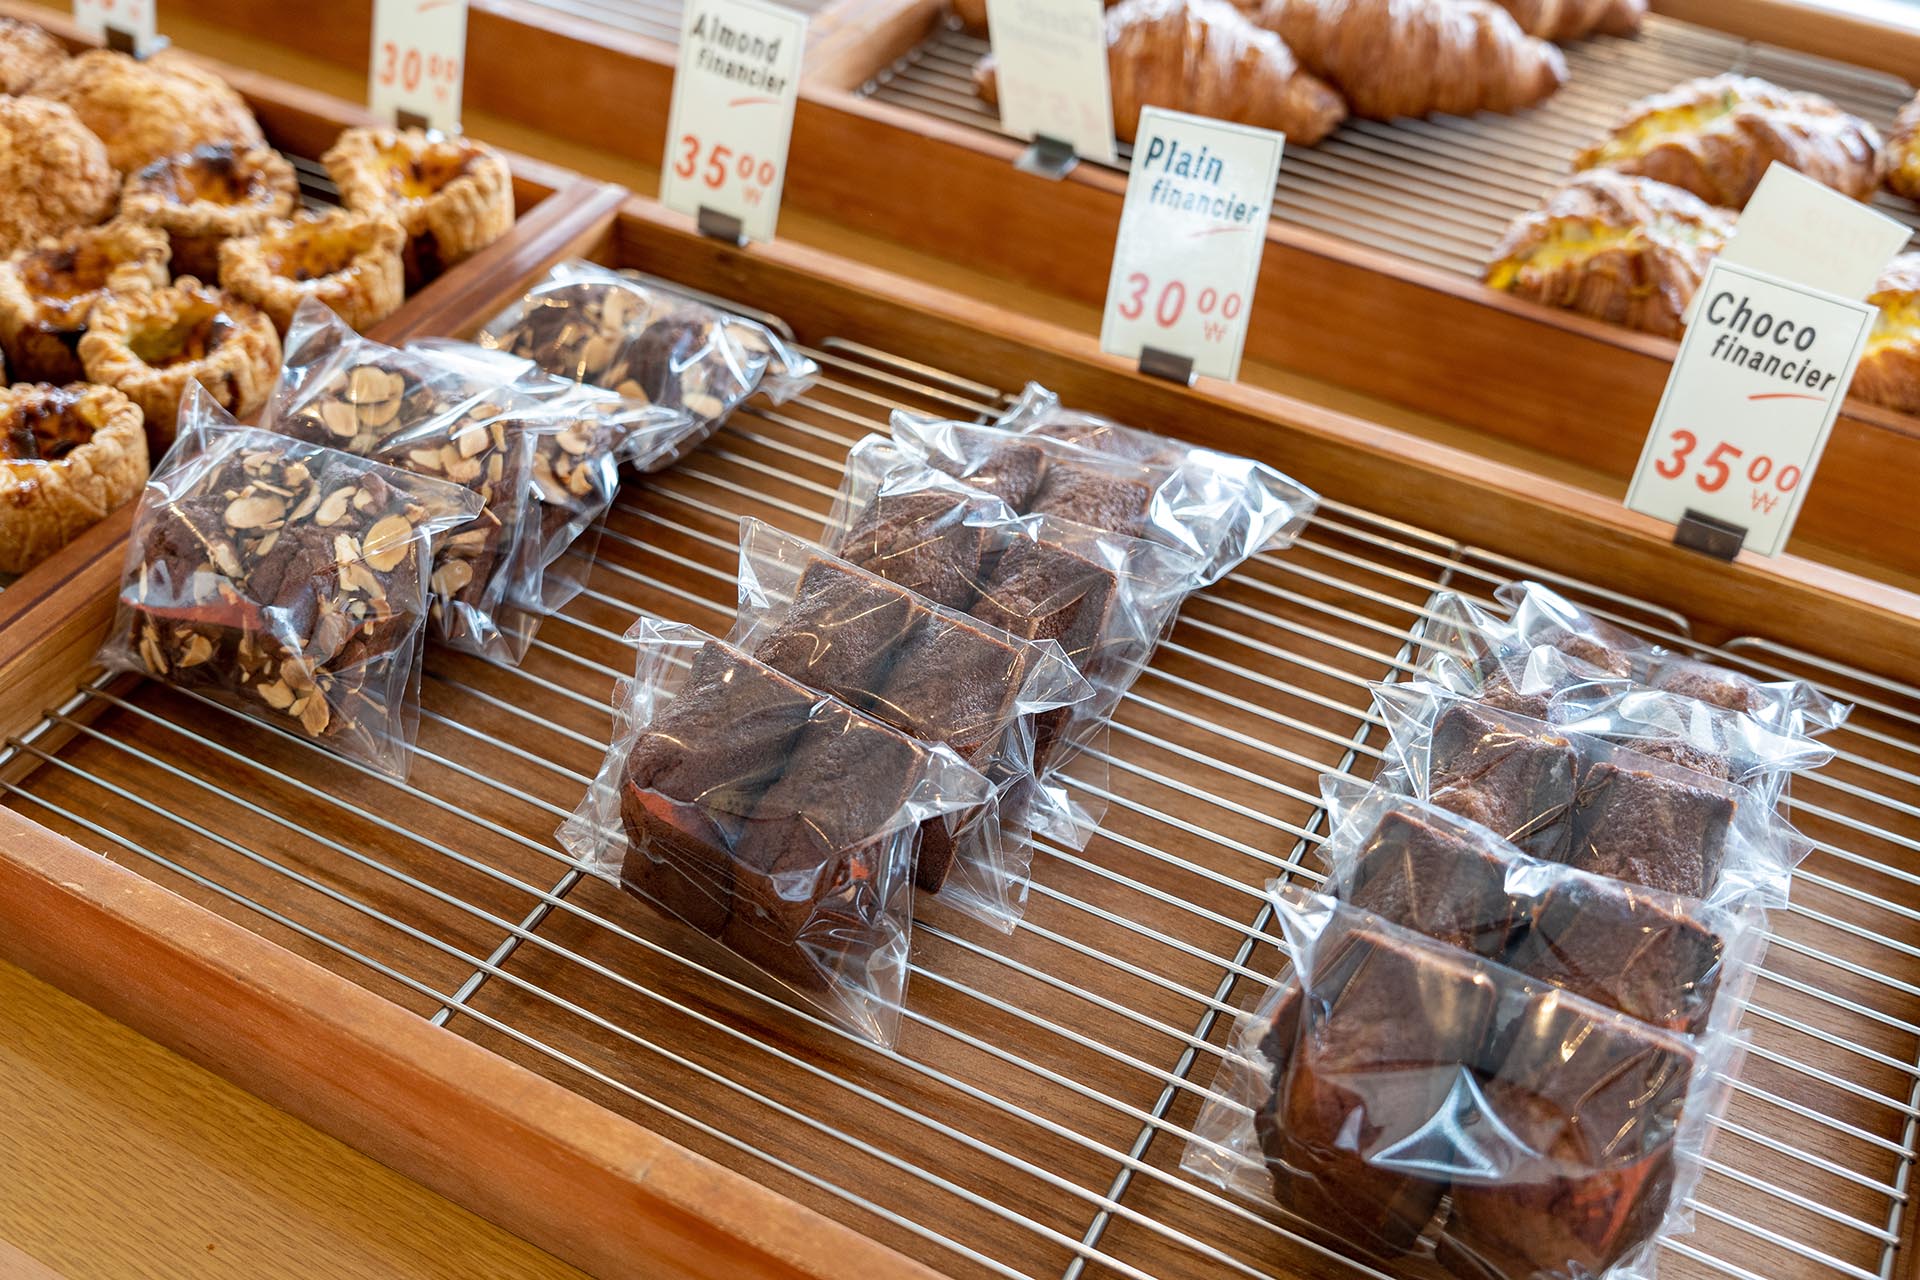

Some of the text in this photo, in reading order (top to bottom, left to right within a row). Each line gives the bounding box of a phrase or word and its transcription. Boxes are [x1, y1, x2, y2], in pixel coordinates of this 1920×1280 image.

[691, 14, 781, 64] Almond
[1143, 136, 1223, 184] Plain
[1150, 179, 1259, 224] financier
[1706, 291, 1817, 352] Choco
[1710, 333, 1838, 392] financier
